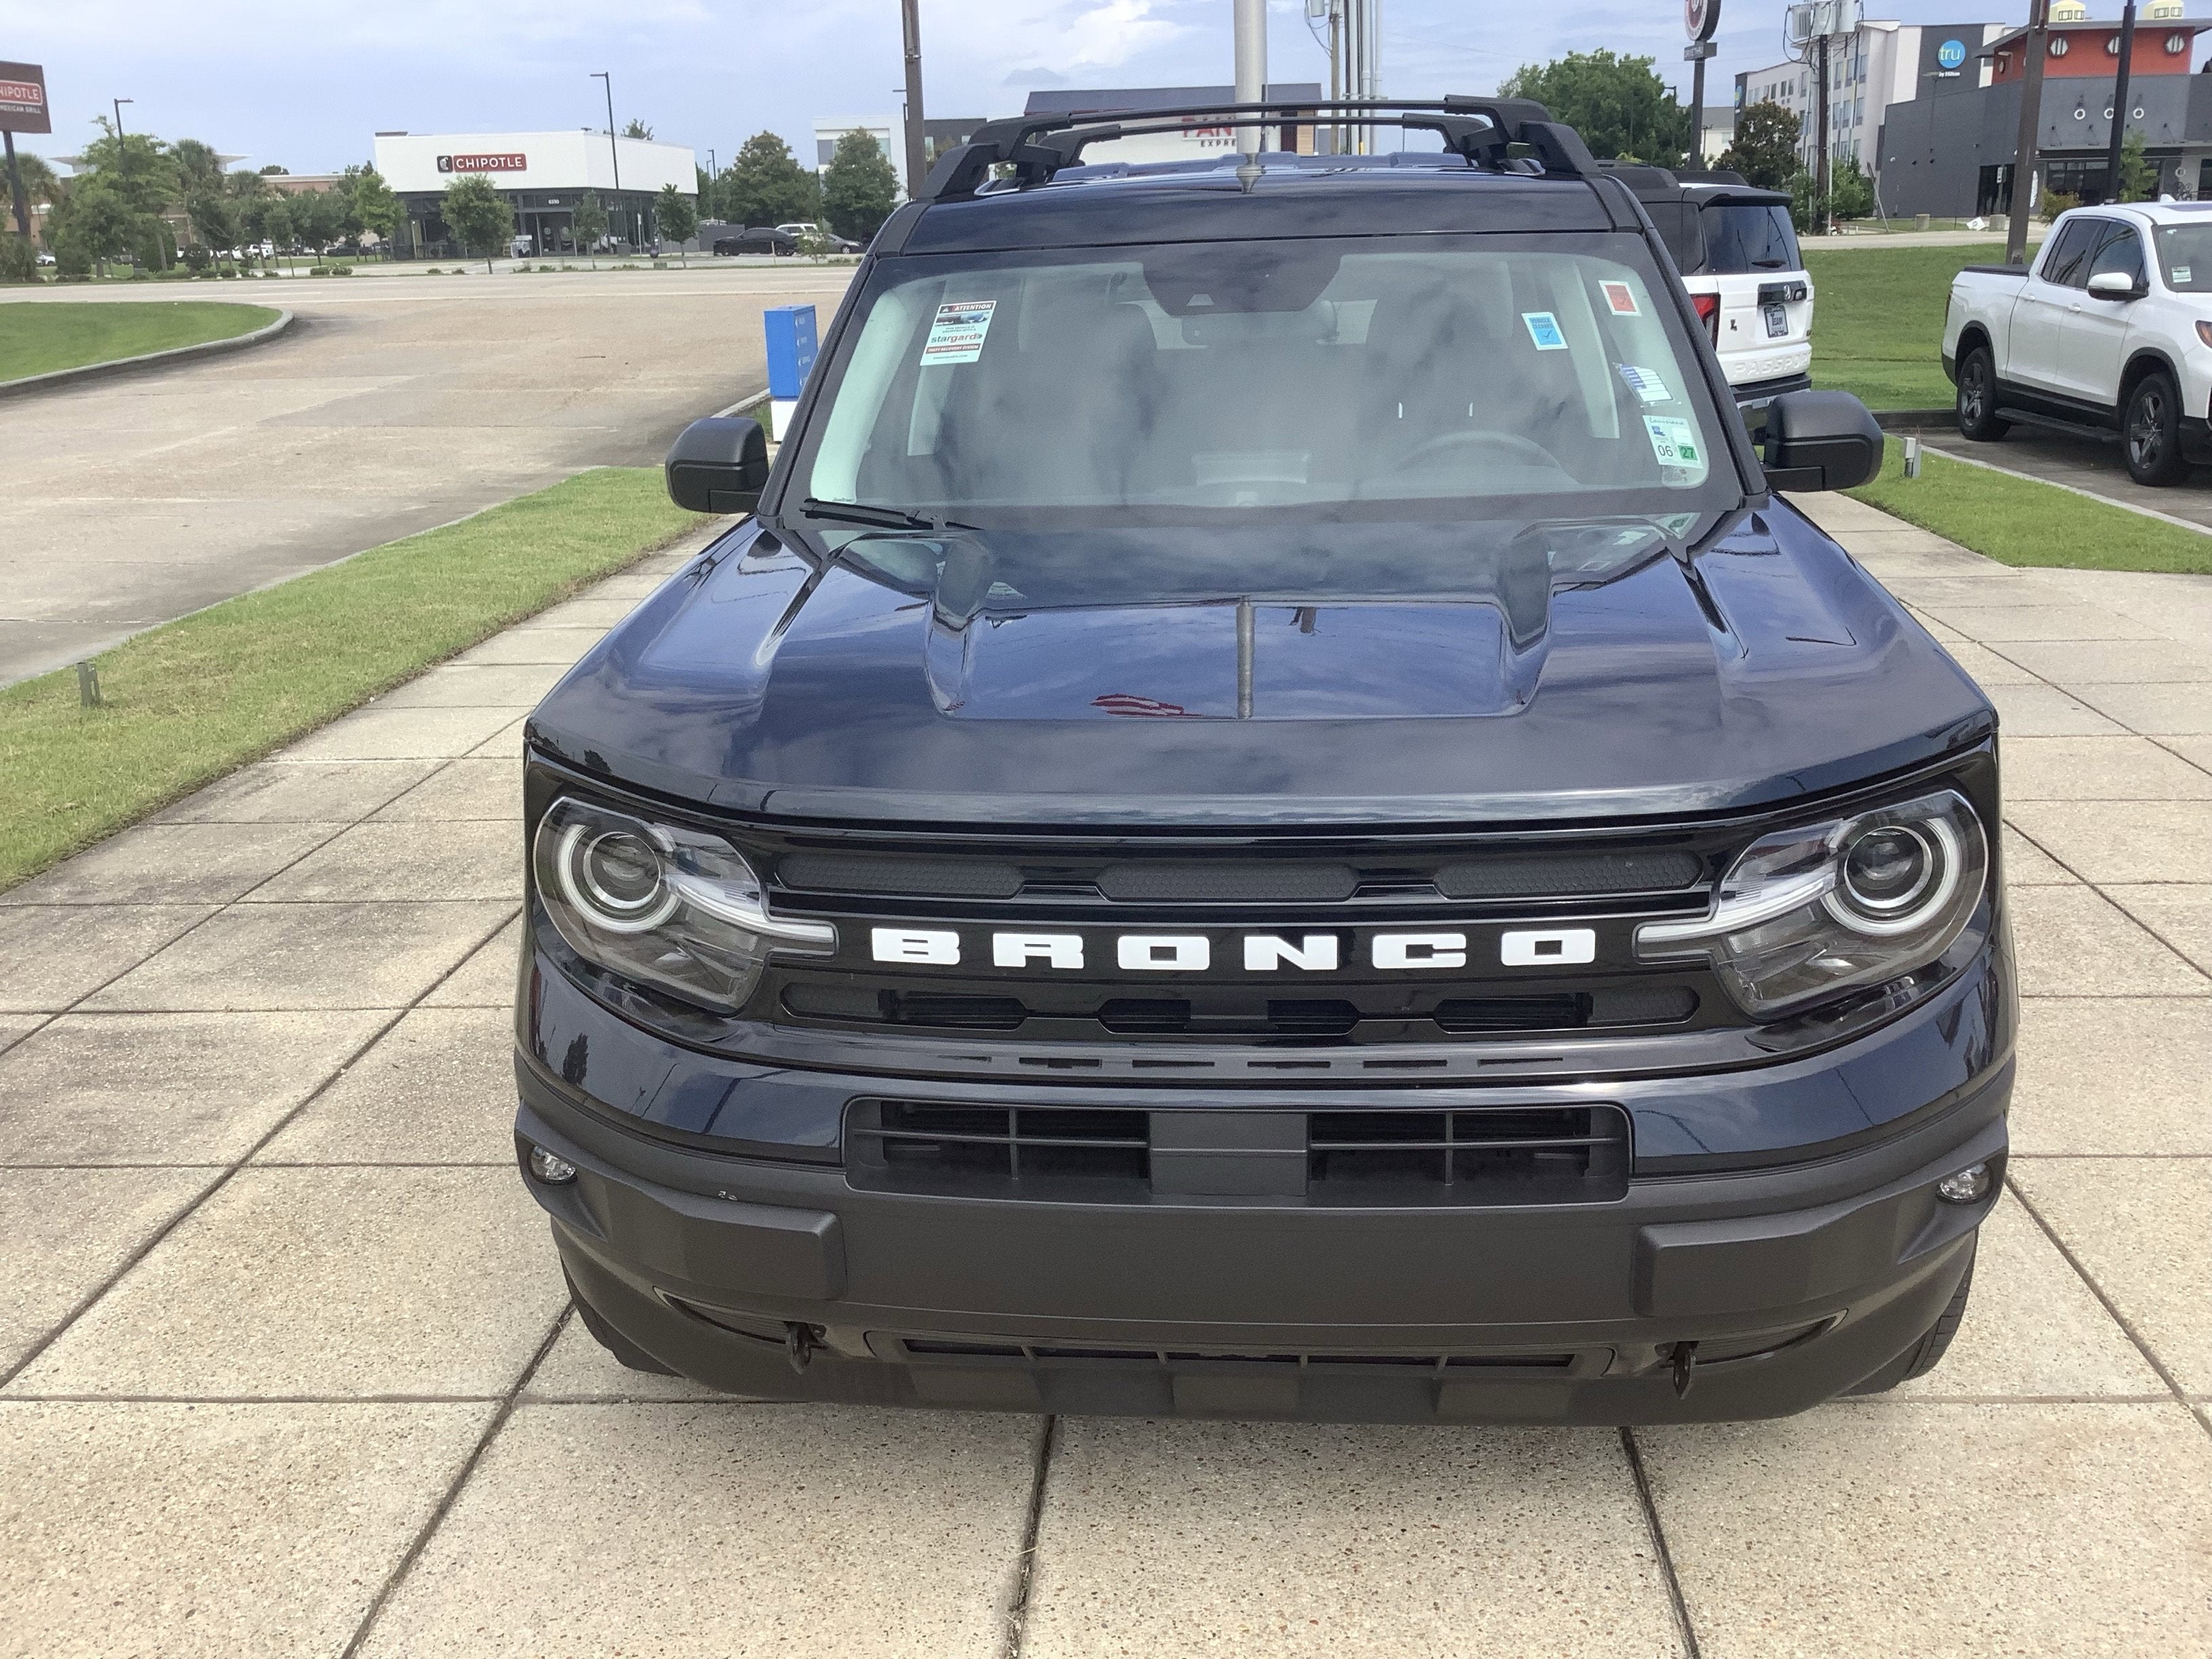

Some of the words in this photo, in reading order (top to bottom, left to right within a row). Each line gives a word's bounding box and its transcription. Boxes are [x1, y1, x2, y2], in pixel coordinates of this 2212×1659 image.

[1939, 47, 1961, 60] tru
[456, 157, 523, 169] CHIPOTLE
[954, 304, 991, 312] ATTENTION
[1658, 445, 1673, 457] 06
[1680, 447, 1694, 458] 27
[871, 928, 1597, 970] BRONCO
